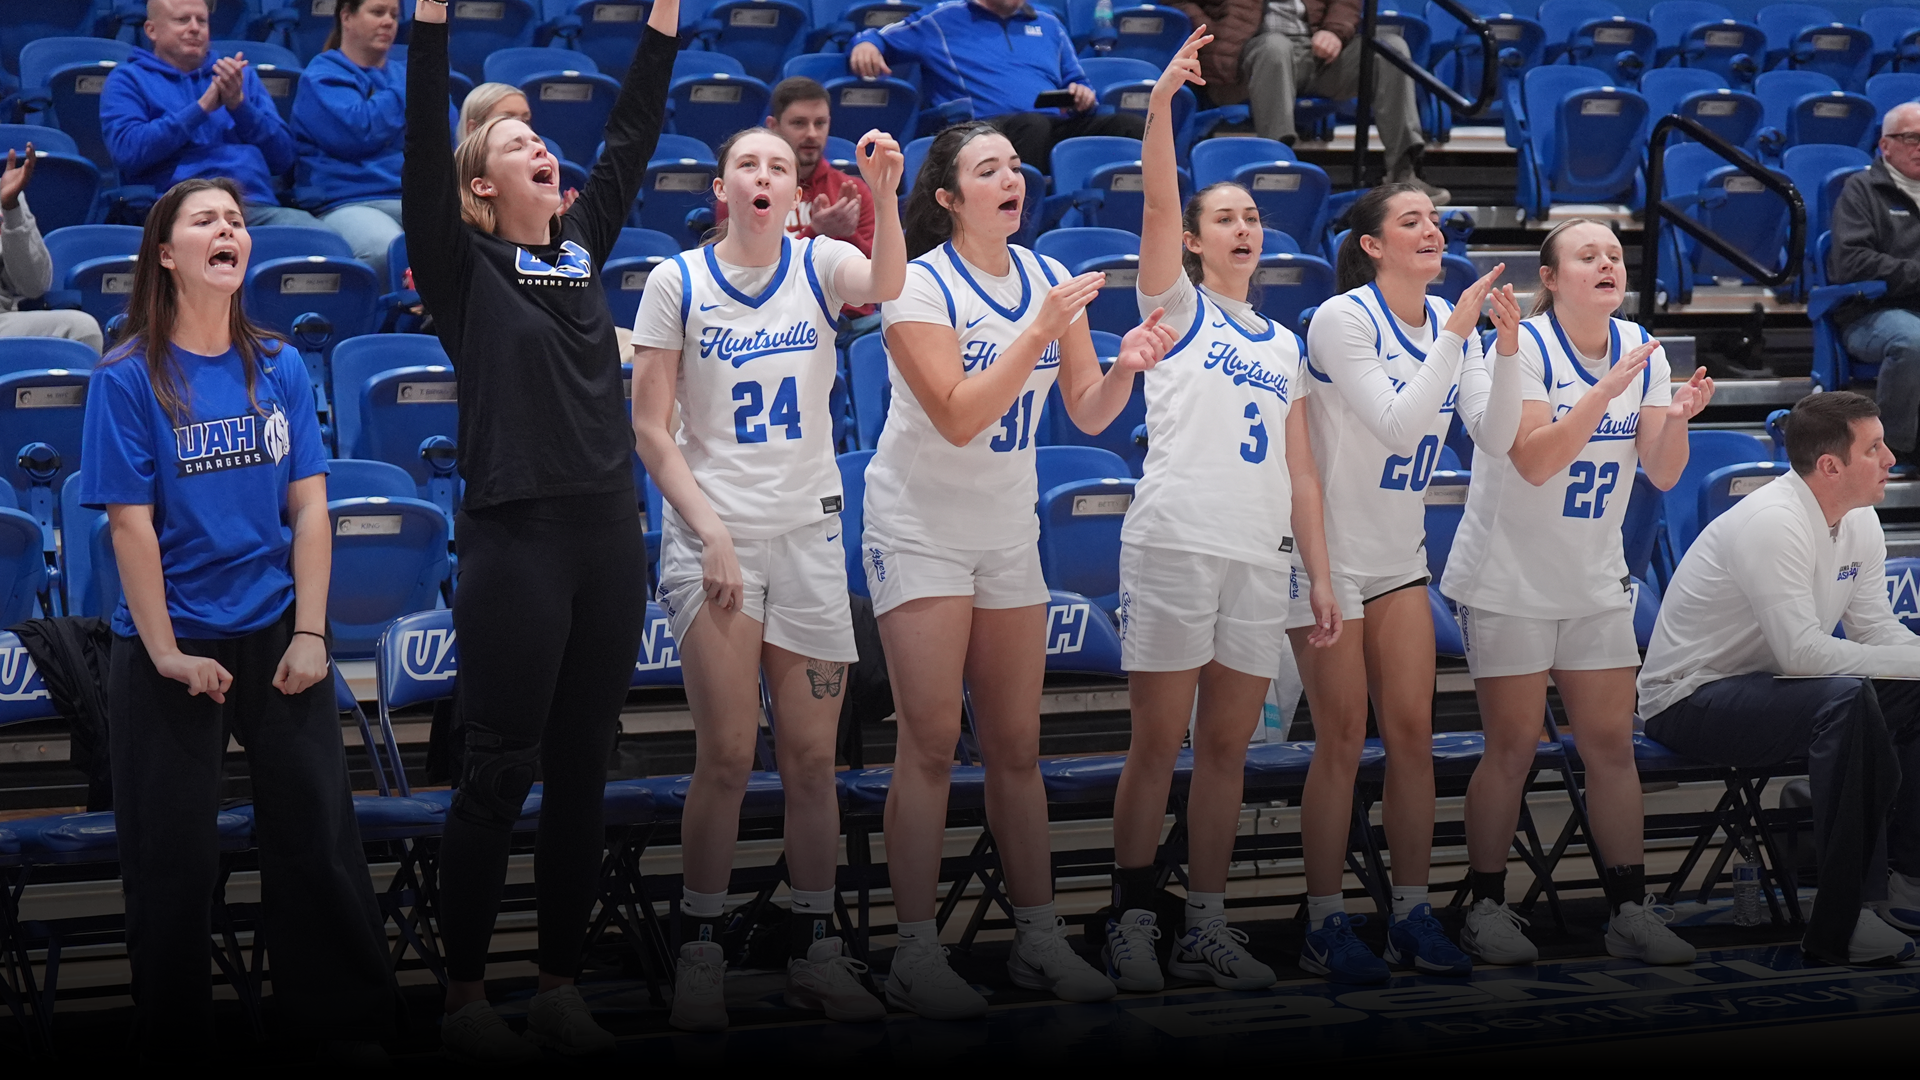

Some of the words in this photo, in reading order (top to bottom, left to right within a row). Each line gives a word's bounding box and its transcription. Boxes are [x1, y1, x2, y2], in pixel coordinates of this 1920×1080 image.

[700, 321, 818, 369] Huntsville
[173, 415, 256, 461] UAH
[731, 376, 802, 444] 24
[989, 390, 1035, 453] 31
[1240, 401, 1269, 464] 3
[185, 452, 263, 474] CHARGERS
[1380, 434, 1439, 492] 20
[1562, 460, 1620, 519] 22
[360, 522, 381, 530] KING
